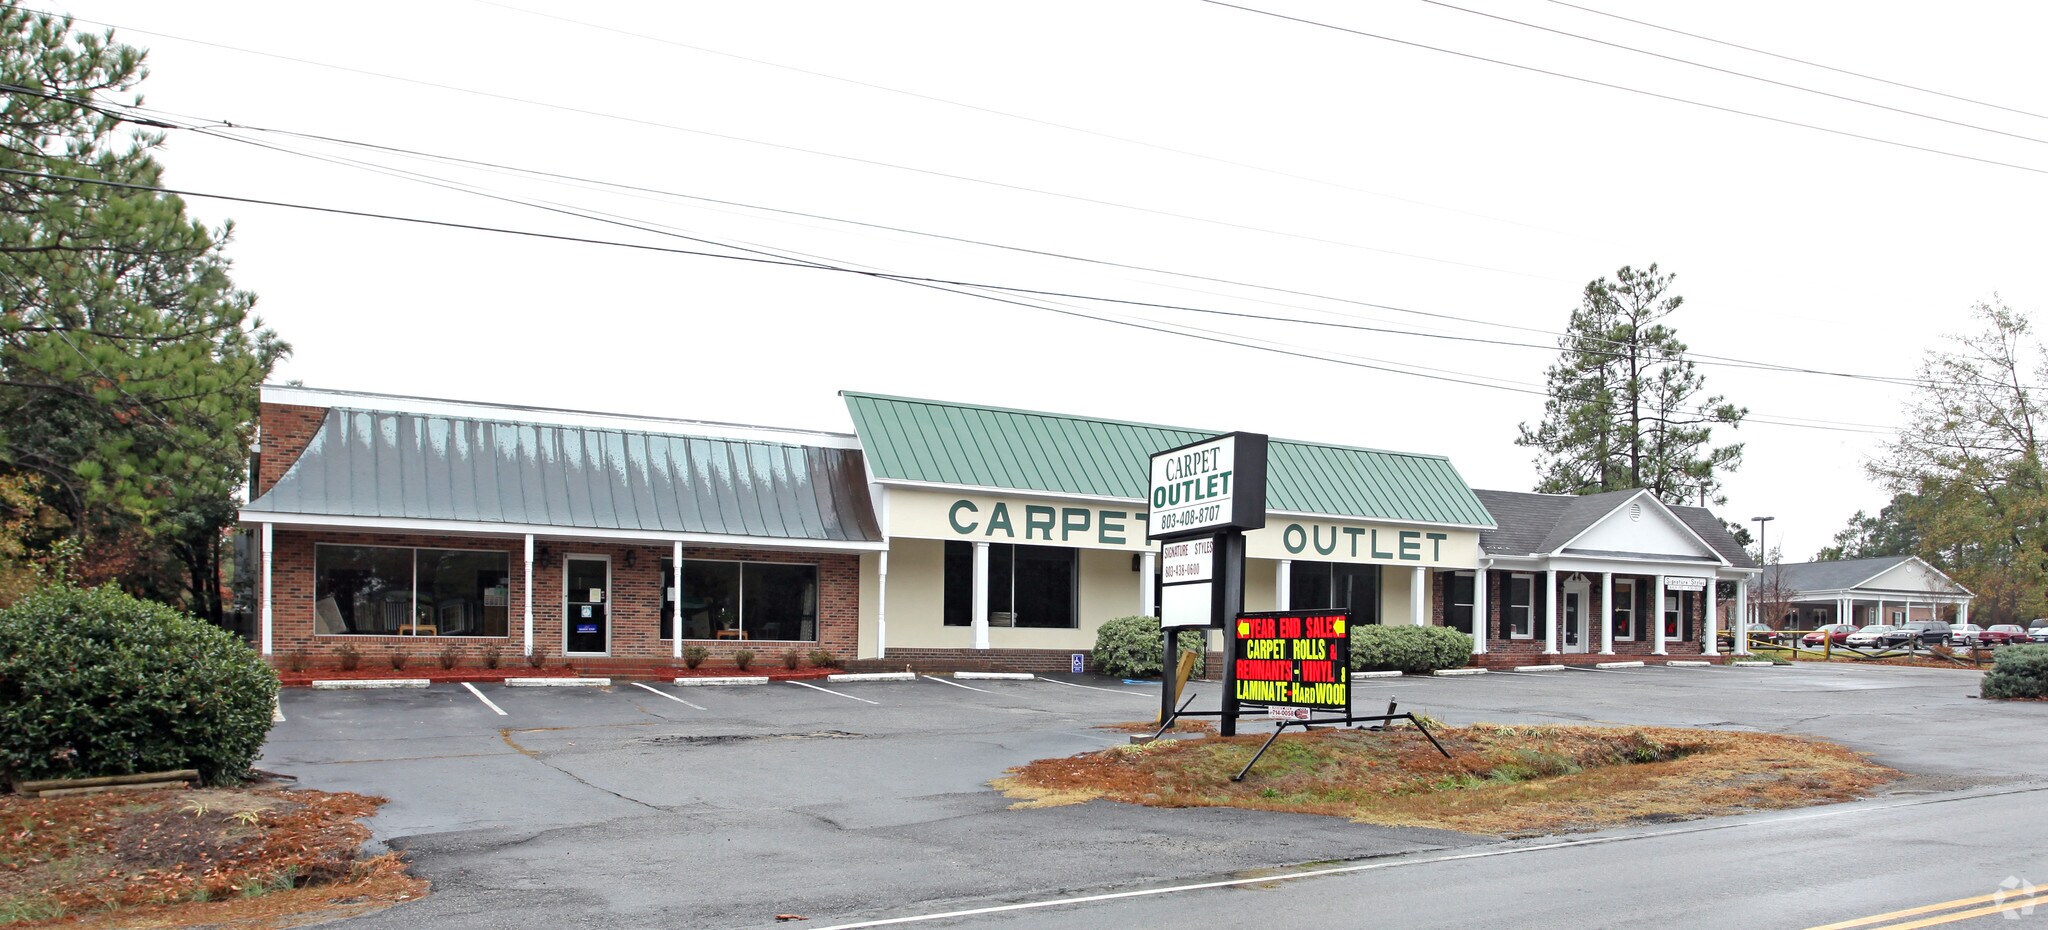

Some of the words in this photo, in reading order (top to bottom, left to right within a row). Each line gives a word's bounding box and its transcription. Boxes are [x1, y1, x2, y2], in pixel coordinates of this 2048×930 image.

[1166, 446, 1220, 481] CARPET
[1153, 470, 1232, 509] OUTLET
[1161, 504, 1220, 530] 803-408-8707
[1165, 544, 1188, 559] SIGNATURE
[1194, 541, 1214, 555] STYLES
[1283, 523, 1447, 562] OUTLET
[1249, 618, 1276, 639] YEAR
[1280, 617, 1301, 638] END
[1305, 616, 1336, 638] SALE
[1247, 638, 1286, 659] CARPET
[1293, 638, 1326, 660] ROLLS
[1330, 643, 1338, 660] &
[1236, 659, 1292, 681] REMNANTS
[1302, 661, 1335, 682] VINYL
